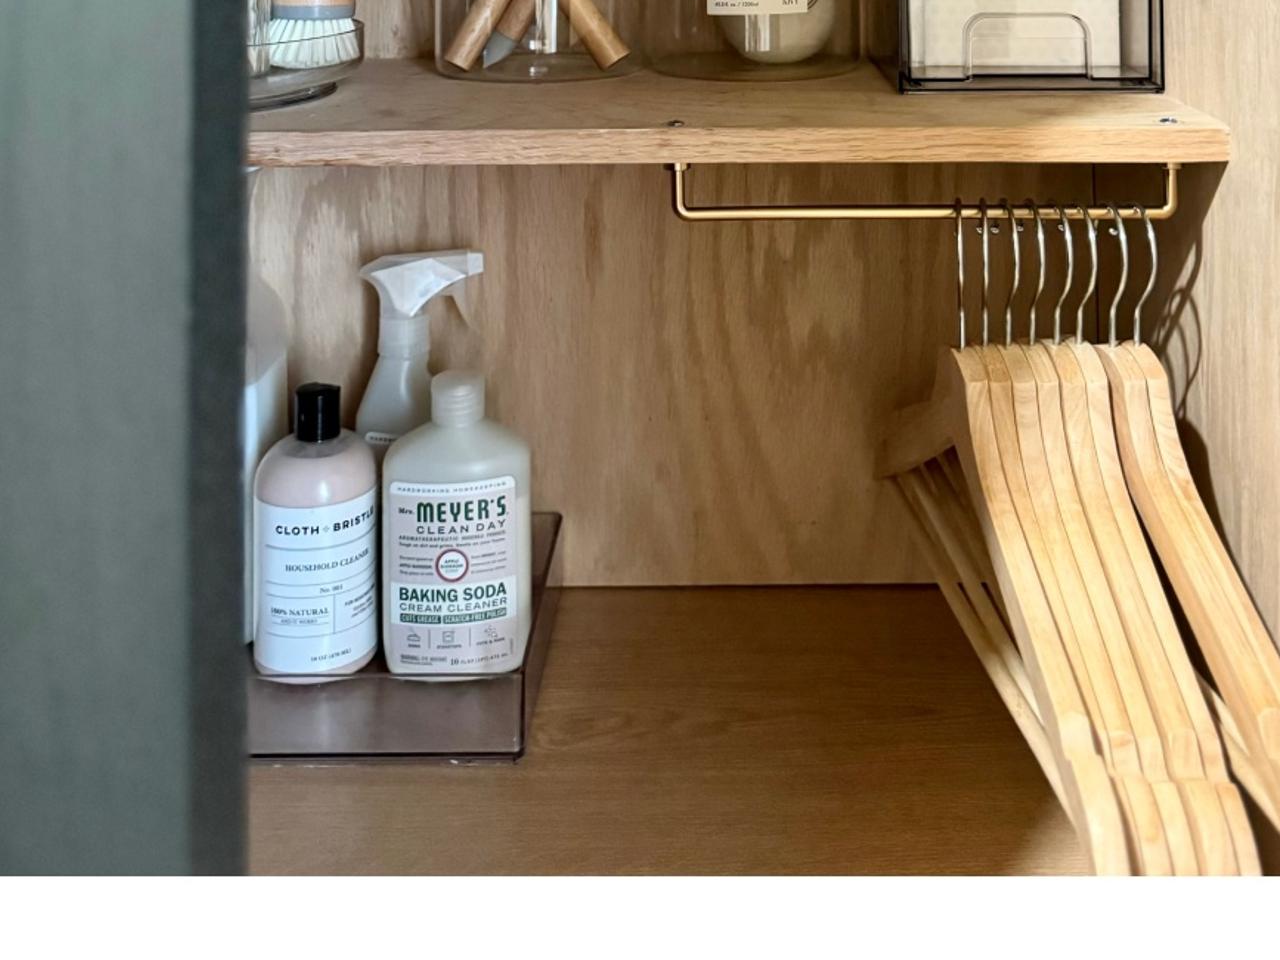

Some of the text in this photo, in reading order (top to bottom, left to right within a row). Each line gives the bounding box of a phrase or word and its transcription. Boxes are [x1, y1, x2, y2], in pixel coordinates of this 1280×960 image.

[398, 495, 506, 523] Mrs. MEYER'S
[275, 525, 320, 536] CLOTH
[416, 519, 506, 535] CLEAN DAY
[285, 561, 338, 572] HOUSEHOLD
[399, 582, 507, 603] BAKING SODA
[289, 607, 329, 616] NATURAL
[399, 596, 507, 613] CREAM CLEANER
